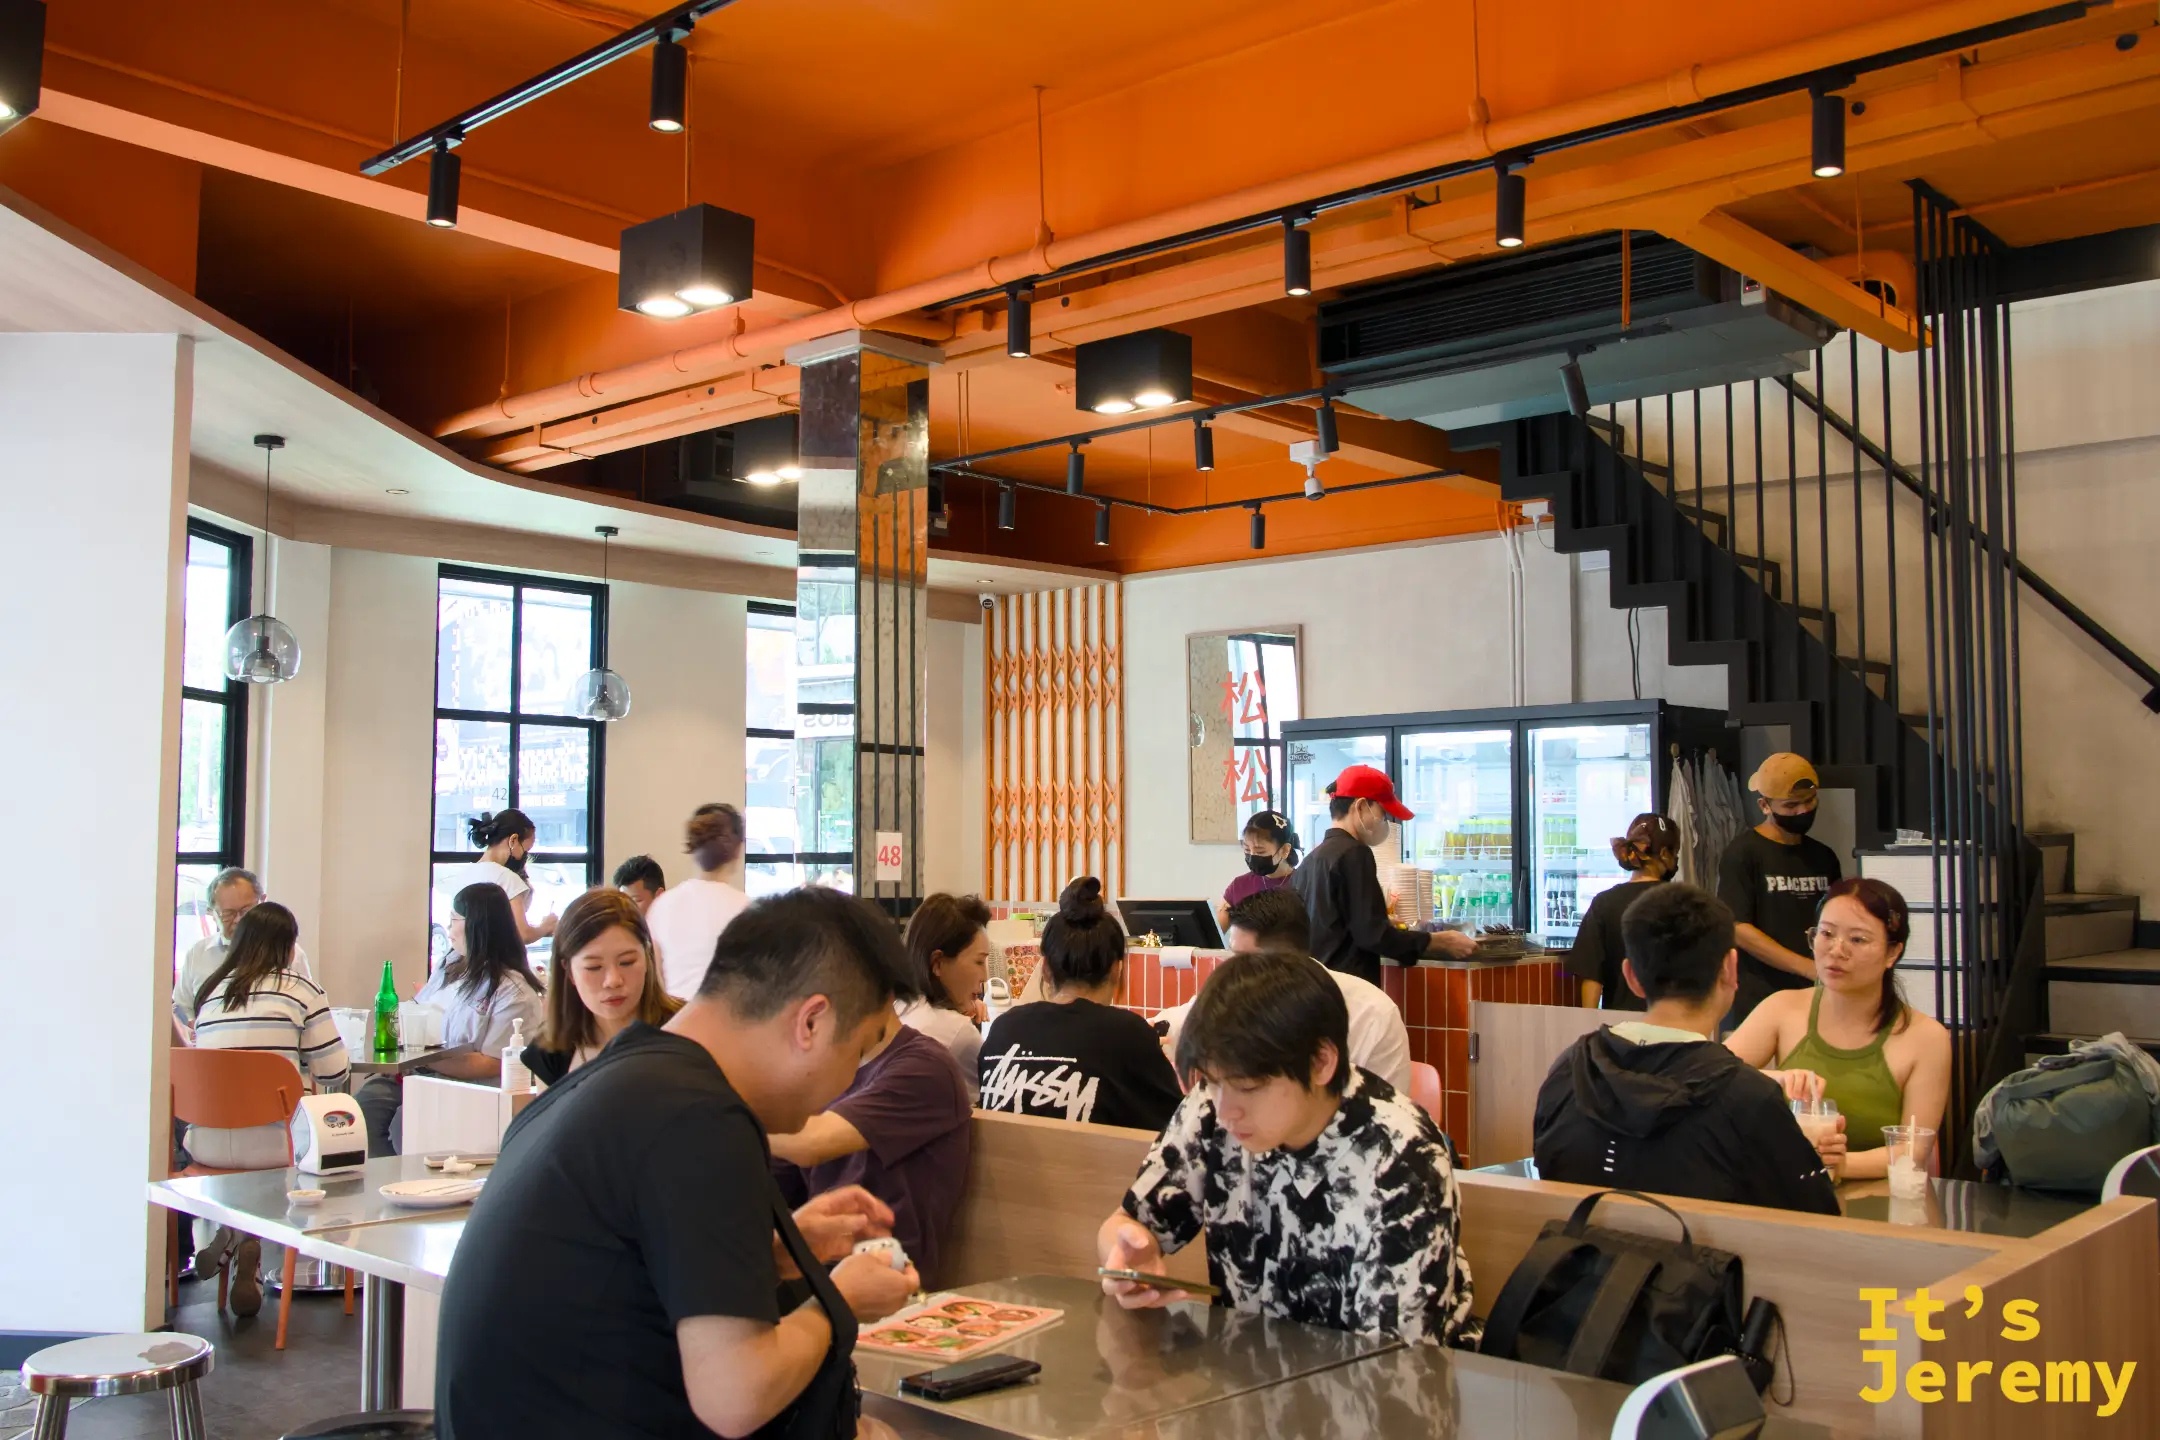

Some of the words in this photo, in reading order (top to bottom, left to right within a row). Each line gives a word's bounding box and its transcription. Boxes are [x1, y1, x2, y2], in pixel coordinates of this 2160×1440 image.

[1220, 670, 1269, 806] 松松
[491, 787, 508, 801] 42
[877, 845, 902, 867] 48
[1765, 875, 1831, 893] PEACEFUL
